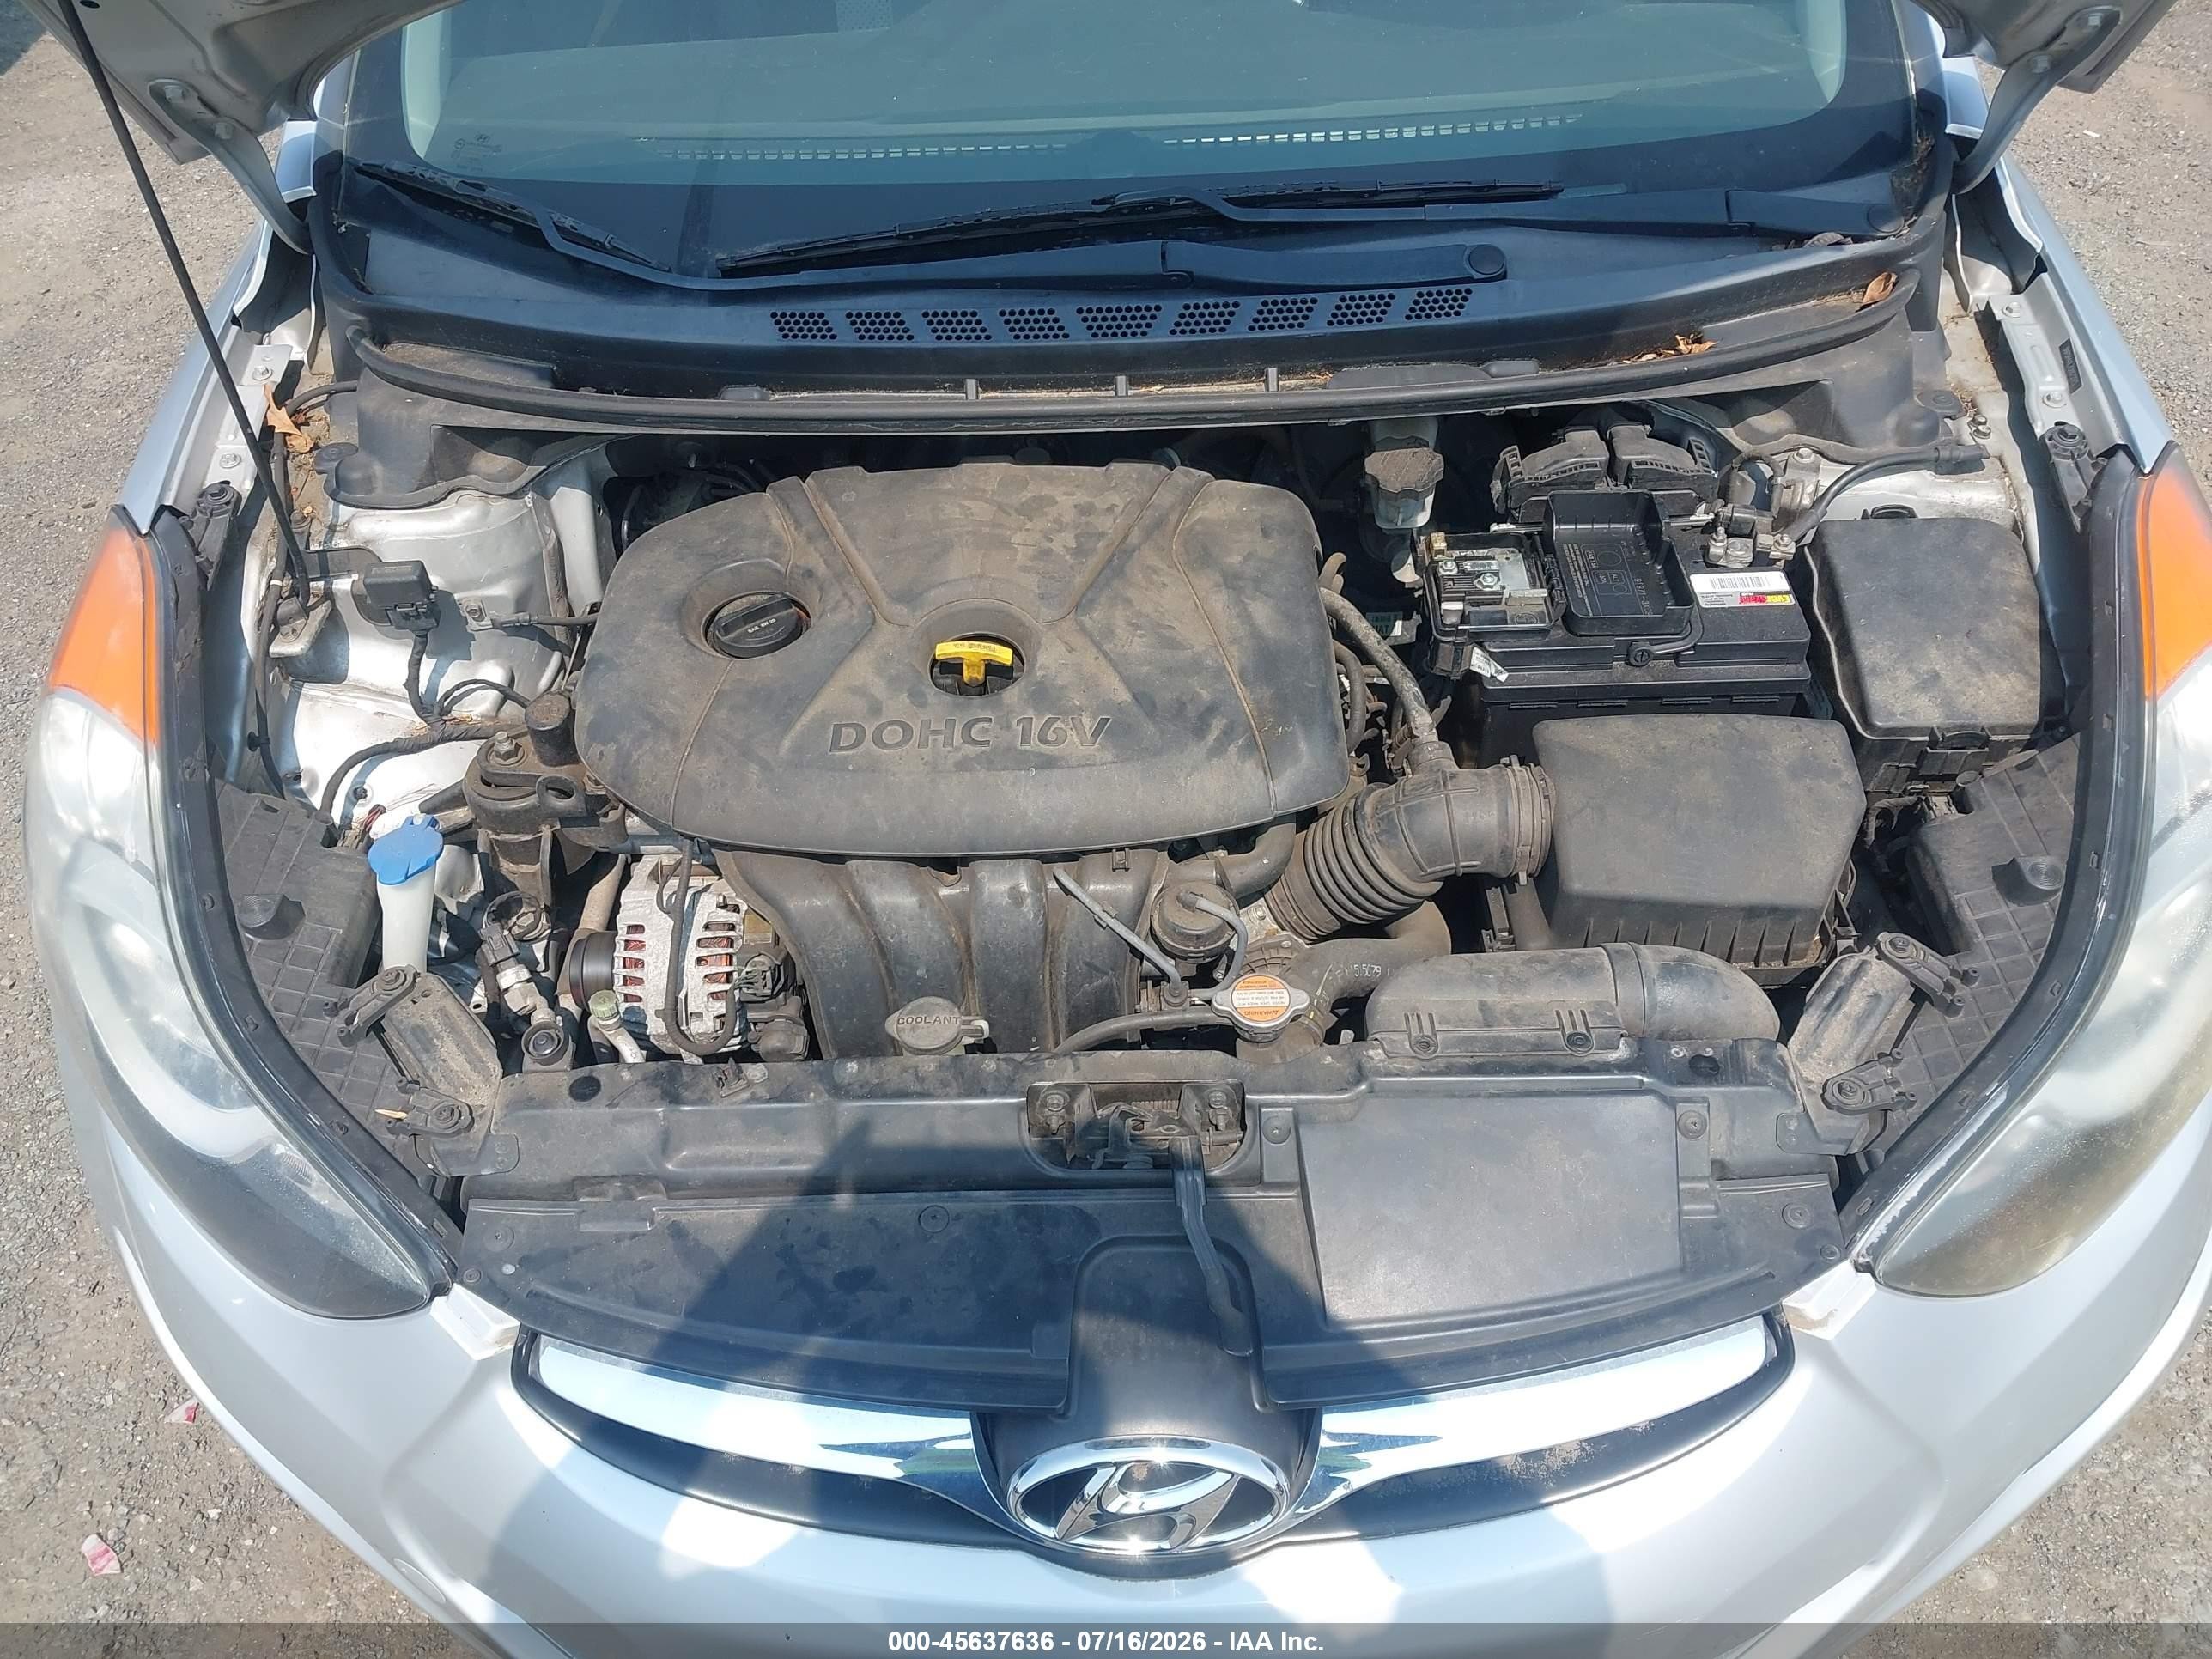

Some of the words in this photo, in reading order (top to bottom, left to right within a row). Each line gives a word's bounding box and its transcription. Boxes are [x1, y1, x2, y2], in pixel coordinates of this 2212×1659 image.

[829, 716, 993, 753] DOHC
[1016, 715, 1112, 747] 16V
[896, 1015, 961, 1026] COOLANT
